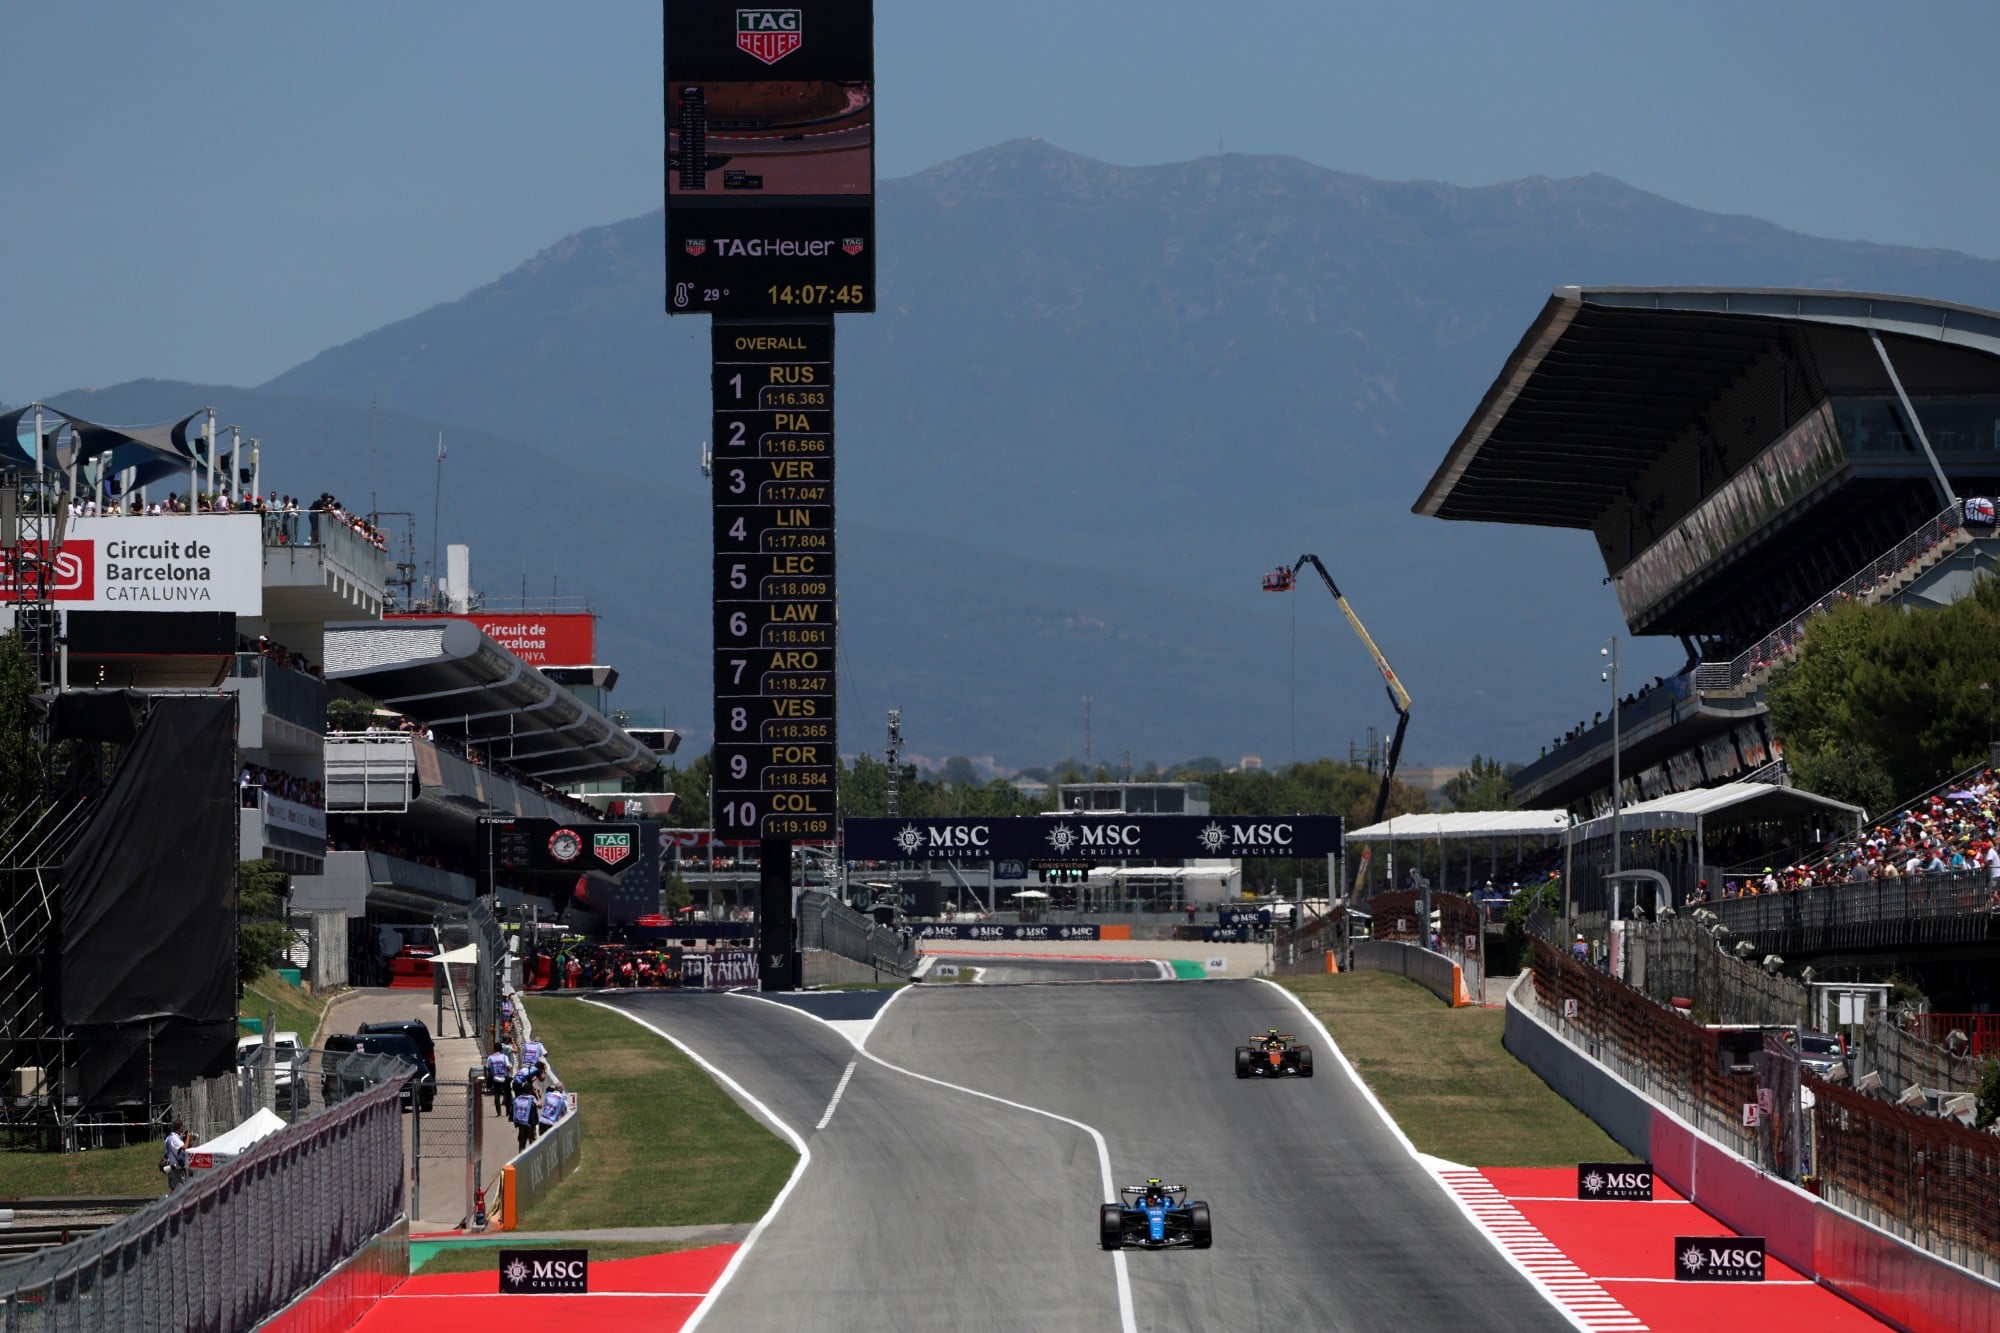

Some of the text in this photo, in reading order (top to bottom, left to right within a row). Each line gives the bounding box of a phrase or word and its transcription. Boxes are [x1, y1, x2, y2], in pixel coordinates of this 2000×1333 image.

[742, 13, 795, 29] TAG
[739, 34, 799, 59] HEUER
[714, 239, 834, 256] TAGHeuer
[768, 285, 862, 304] 14:07:45
[736, 337, 806, 349] OVERALL
[771, 367, 813, 383] RUS
[730, 374, 741, 398] 1
[767, 393, 824, 404] 1:16.363
[776, 414, 809, 430] PIA
[729, 422, 745, 445] 2
[767, 440, 824, 452] 1:16.566
[771, 462, 814, 478] VER
[730, 469, 745, 493] 3
[768, 488, 824, 499] 1:17.047
[777, 510, 809, 526] LIN
[729, 517, 746, 541] 4
[768, 535, 825, 547] 1:17.804
[107, 540, 210, 559] Circuit de
[107, 563, 210, 580] Barcelona
[773, 556, 814, 573] LEC
[731, 564, 746, 589] 5
[106, 587, 210, 600] CATALUNYA
[768, 583, 825, 595] 1:18.009
[771, 604, 817, 621] LAW
[530, 624, 546, 635] de
[730, 612, 747, 636] 6
[498, 637, 546, 649] rcelona
[768, 631, 824, 642] 1:18.061
[770, 652, 817, 668] ARO
[731, 660, 746, 684] 7
[768, 678, 826, 690] 1:18.247
[773, 699, 815, 716] VES
[731, 707, 747, 731] 8
[768, 725, 827, 737] 1:18.365
[773, 747, 816, 763] FOR
[731, 755, 747, 779] 9
[769, 773, 827, 785] 1:18.584
[773, 794, 816, 811] COL
[723, 802, 756, 826] 10
[769, 821, 826, 832] 1:19.169
[1232, 824, 1292, 844] MSC
[599, 836, 626, 846] TAG
[929, 826, 988, 846] MSC
[1081, 825, 1140, 845] MSC
[597, 847, 628, 862] HEUER
[935, 926, 958, 935] MSC
[980, 927, 1004, 936] MSC
[1026, 927, 1049, 936] MSC
[1071, 927, 1094, 936] MSC
[1607, 1173, 1649, 1188] MSC
[1710, 1249, 1761, 1267] MSC
[533, 1261, 583, 1278] MSC
